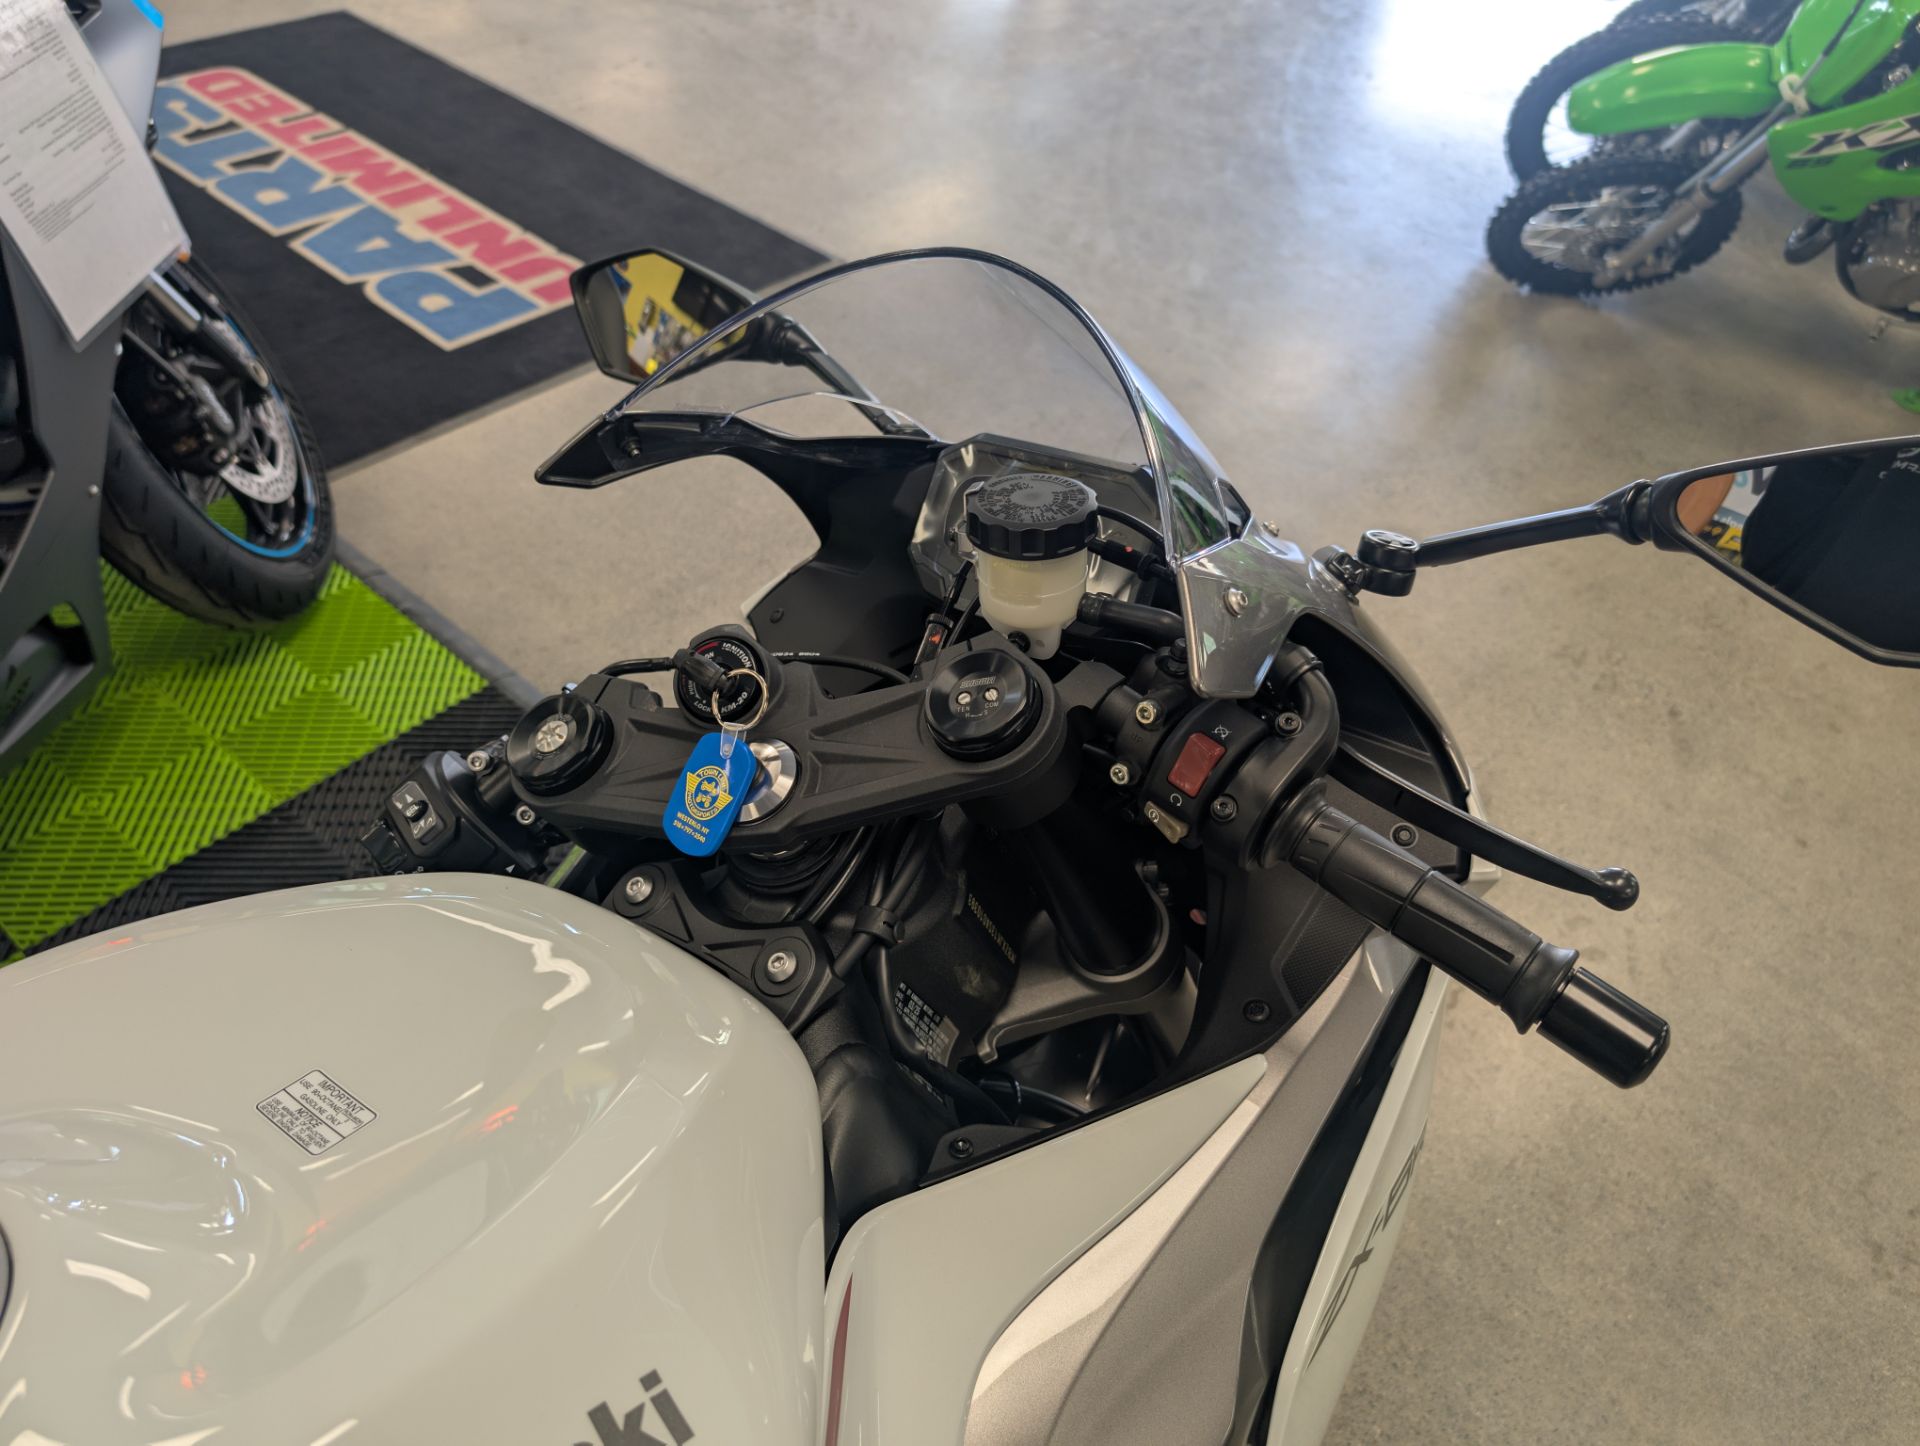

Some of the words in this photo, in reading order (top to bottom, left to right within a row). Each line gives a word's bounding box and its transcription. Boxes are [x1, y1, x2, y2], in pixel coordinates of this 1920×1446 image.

[185, 70, 573, 304] UNLIMITED
[153, 84, 540, 348] PARTS
[704, 651, 714, 660] ON
[721, 642, 753, 668] IGNITION
[694, 701, 712, 713] LOCK
[720, 691, 748, 714] KM-20
[698, 768, 719, 778] TOWN
[687, 790, 719, 818] MOTORSPORTS
[299, 1079, 314, 1090] USE
[318, 1079, 365, 1114] IMPORTANT
[294, 1107, 323, 1128] NOTICE
[299, 1093, 328, 1116] GASOLINE
[325, 1113, 344, 1127] ONLY
